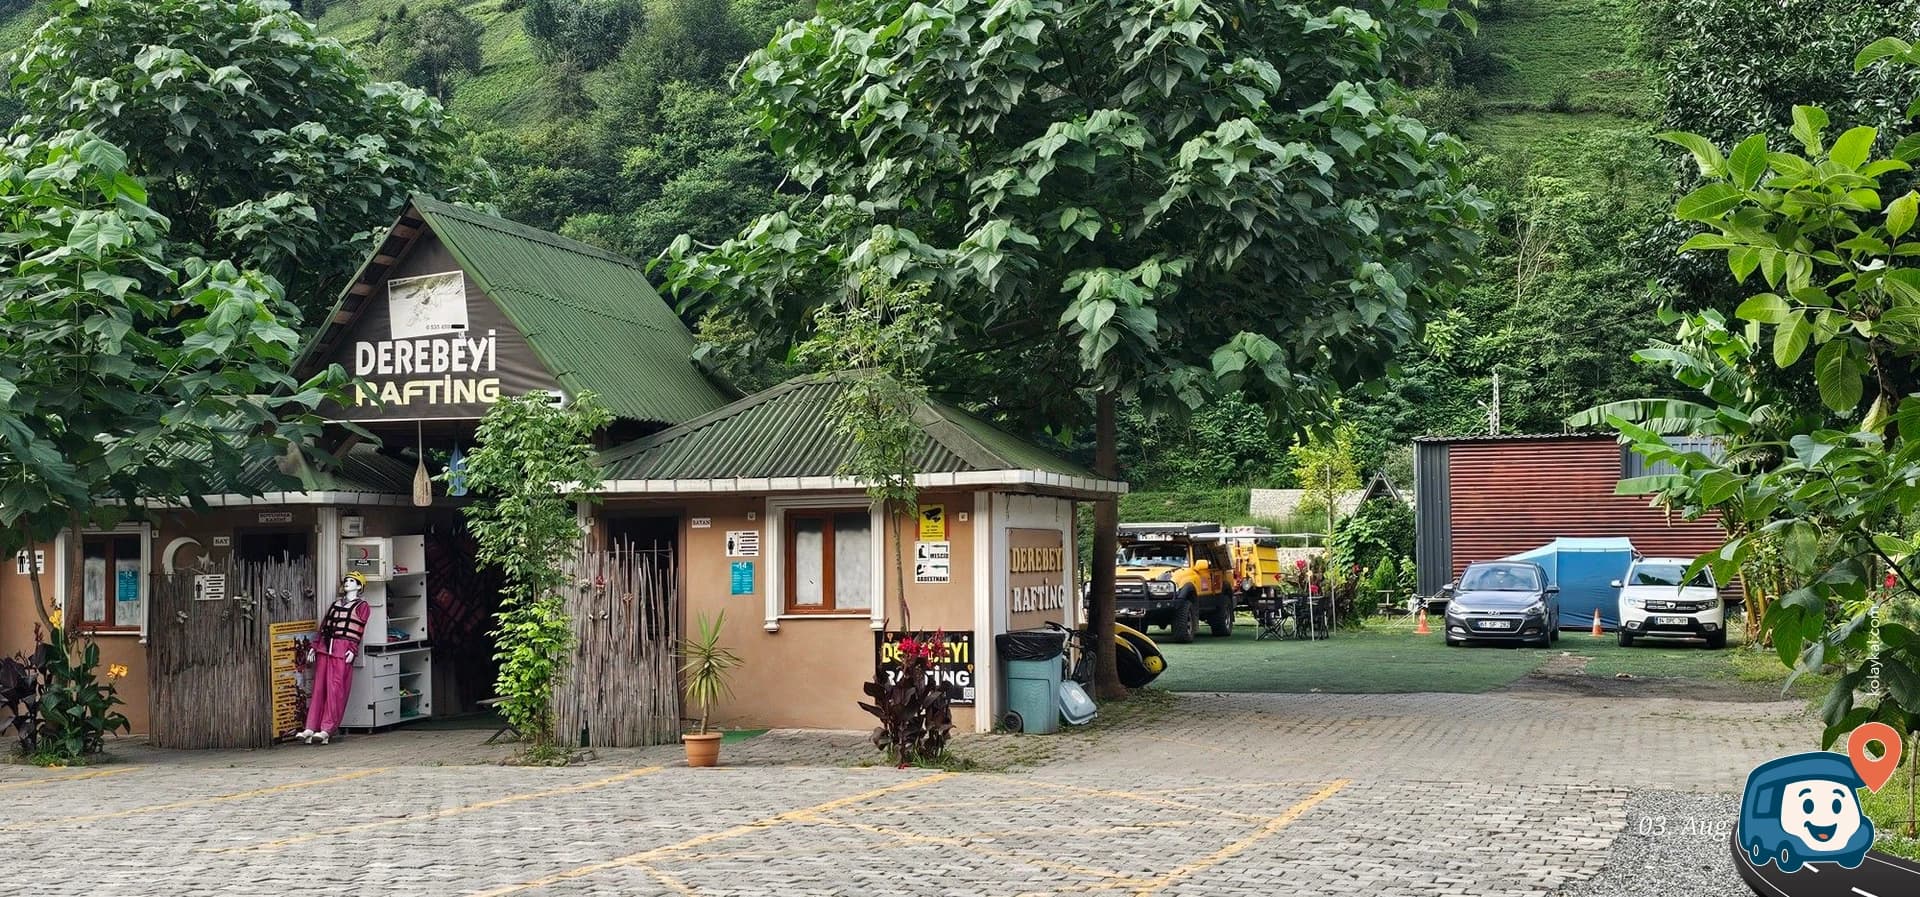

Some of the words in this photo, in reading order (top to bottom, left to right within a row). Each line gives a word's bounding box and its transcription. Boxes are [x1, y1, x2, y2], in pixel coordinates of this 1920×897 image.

[355, 329, 496, 376] DEREBEYİ
[354, 374, 500, 408] RAFTİNG
[1012, 577, 1064, 613] RAFTİNG
[885, 664, 970, 686] RTİNG
